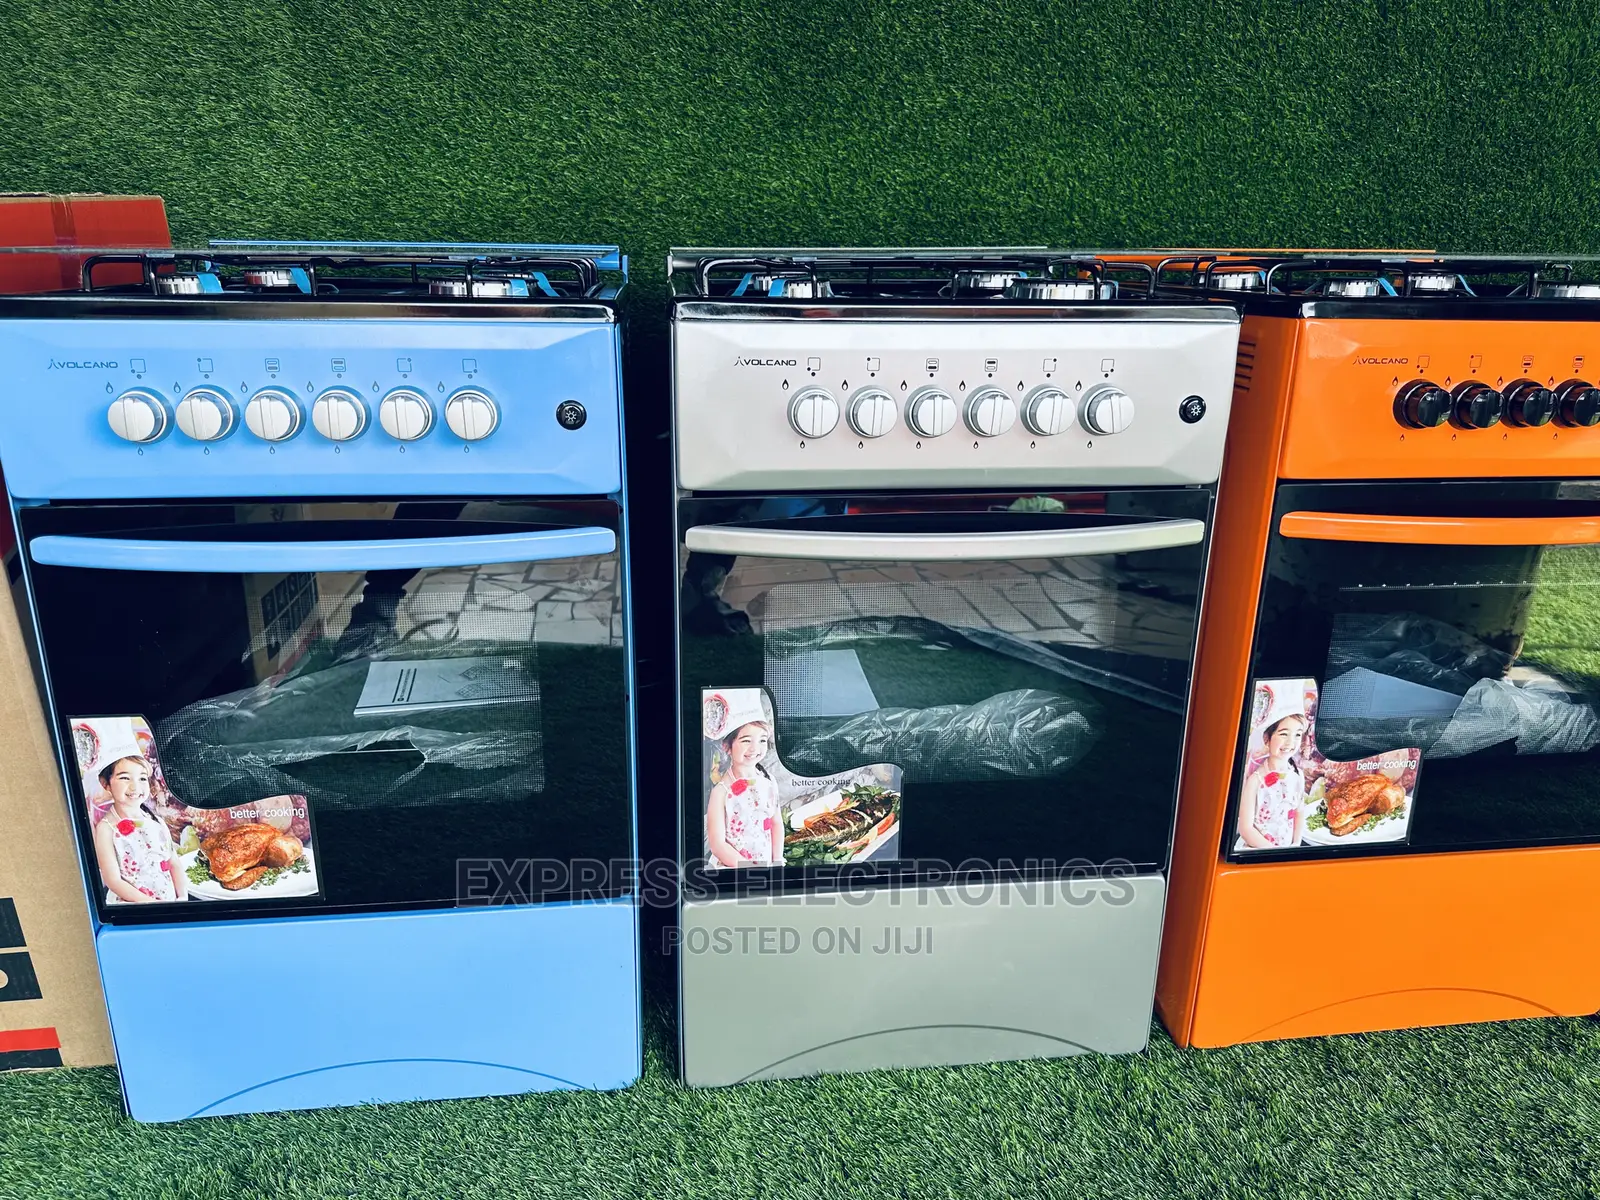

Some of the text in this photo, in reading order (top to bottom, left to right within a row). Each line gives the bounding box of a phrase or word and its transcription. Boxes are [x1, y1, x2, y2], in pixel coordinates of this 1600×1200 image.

[57, 361, 119, 369] VOLCANO
[743, 358, 797, 367] VOLCANO
[1361, 357, 1409, 365] VOLCANO
[1356, 759, 1417, 770] better cooking
[791, 778, 851, 787] better cooking
[229, 806, 305, 819] better cooking
